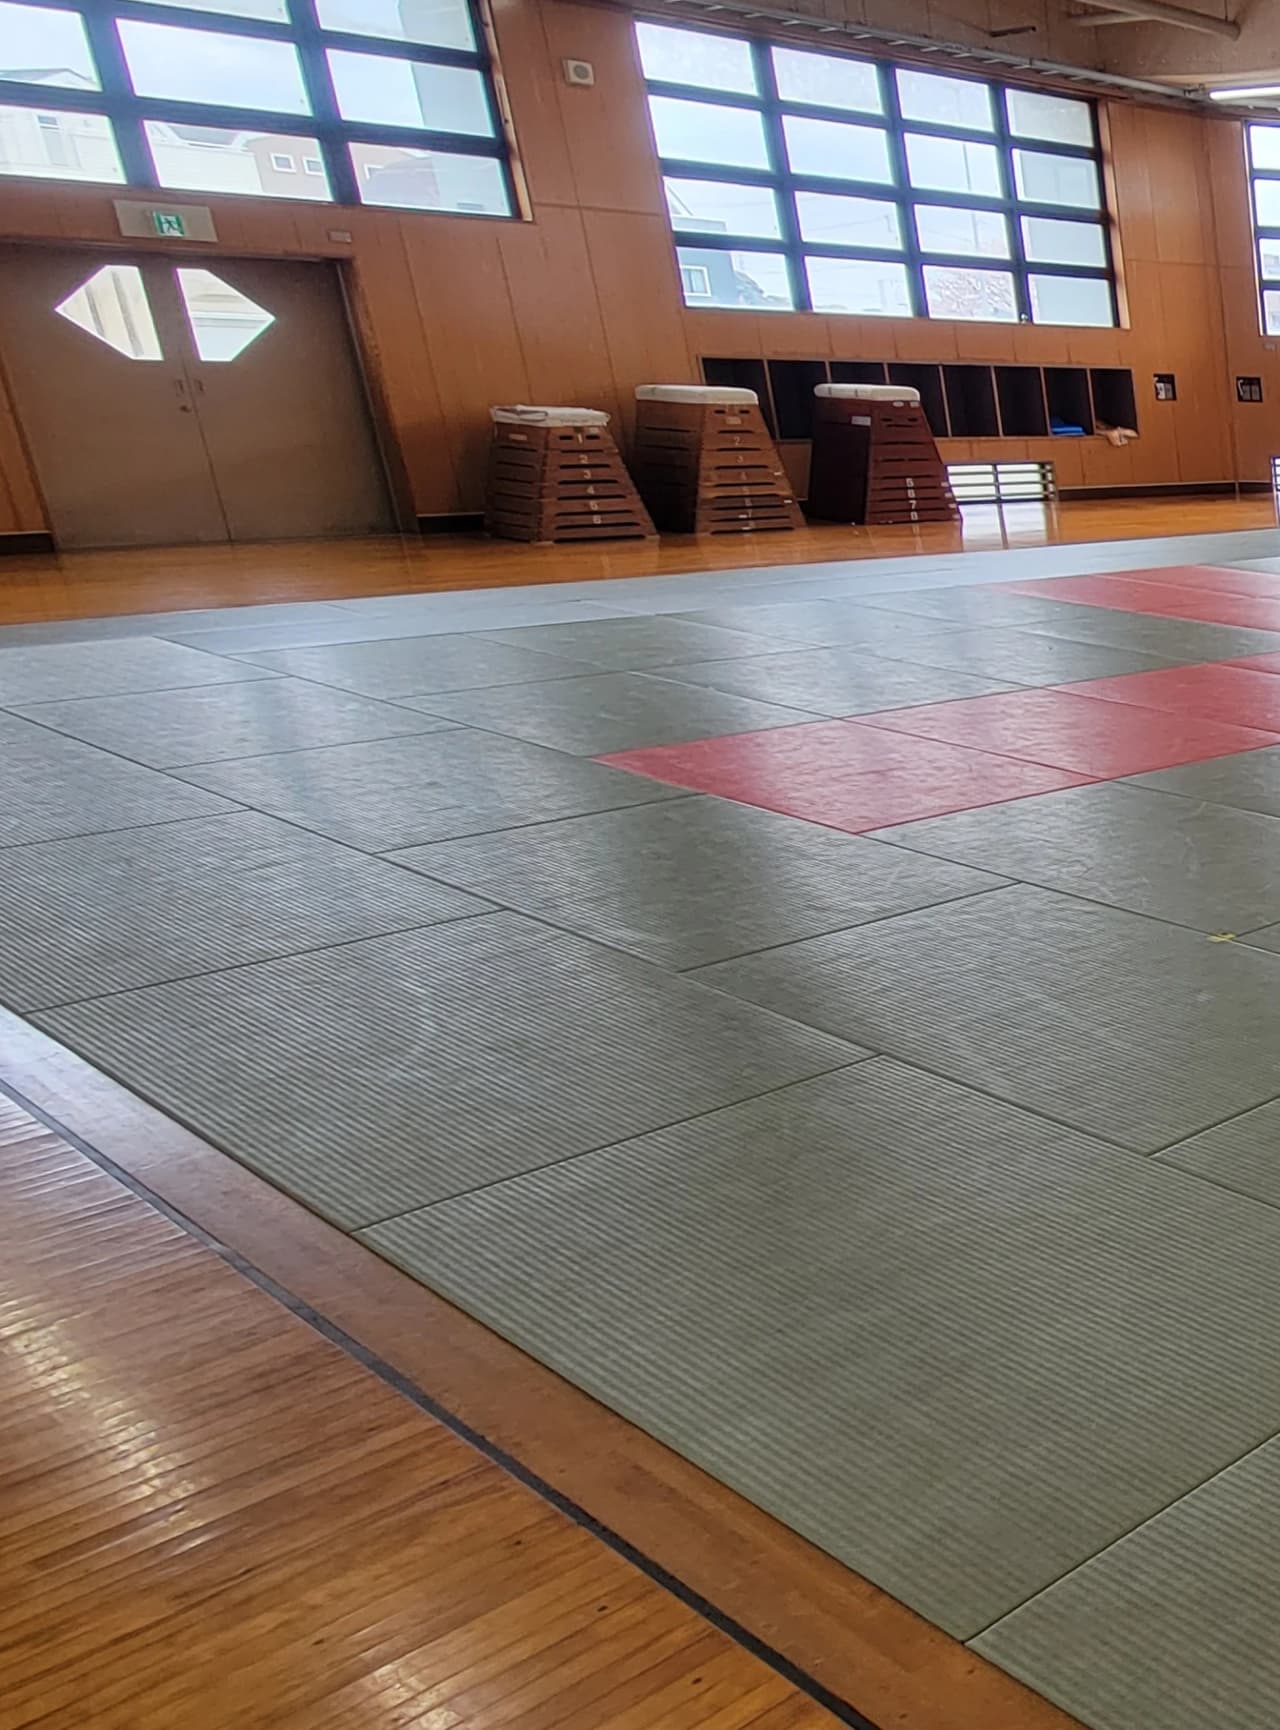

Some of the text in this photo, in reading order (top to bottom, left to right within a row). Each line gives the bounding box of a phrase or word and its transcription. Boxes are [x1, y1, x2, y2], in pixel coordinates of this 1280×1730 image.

[733, 436, 741, 446] 2
[579, 455, 588, 464] 2
[737, 455, 744, 463] 3
[906, 477, 914, 487] 5
[586, 486, 596, 495] 4
[909, 500, 917, 509] 7
